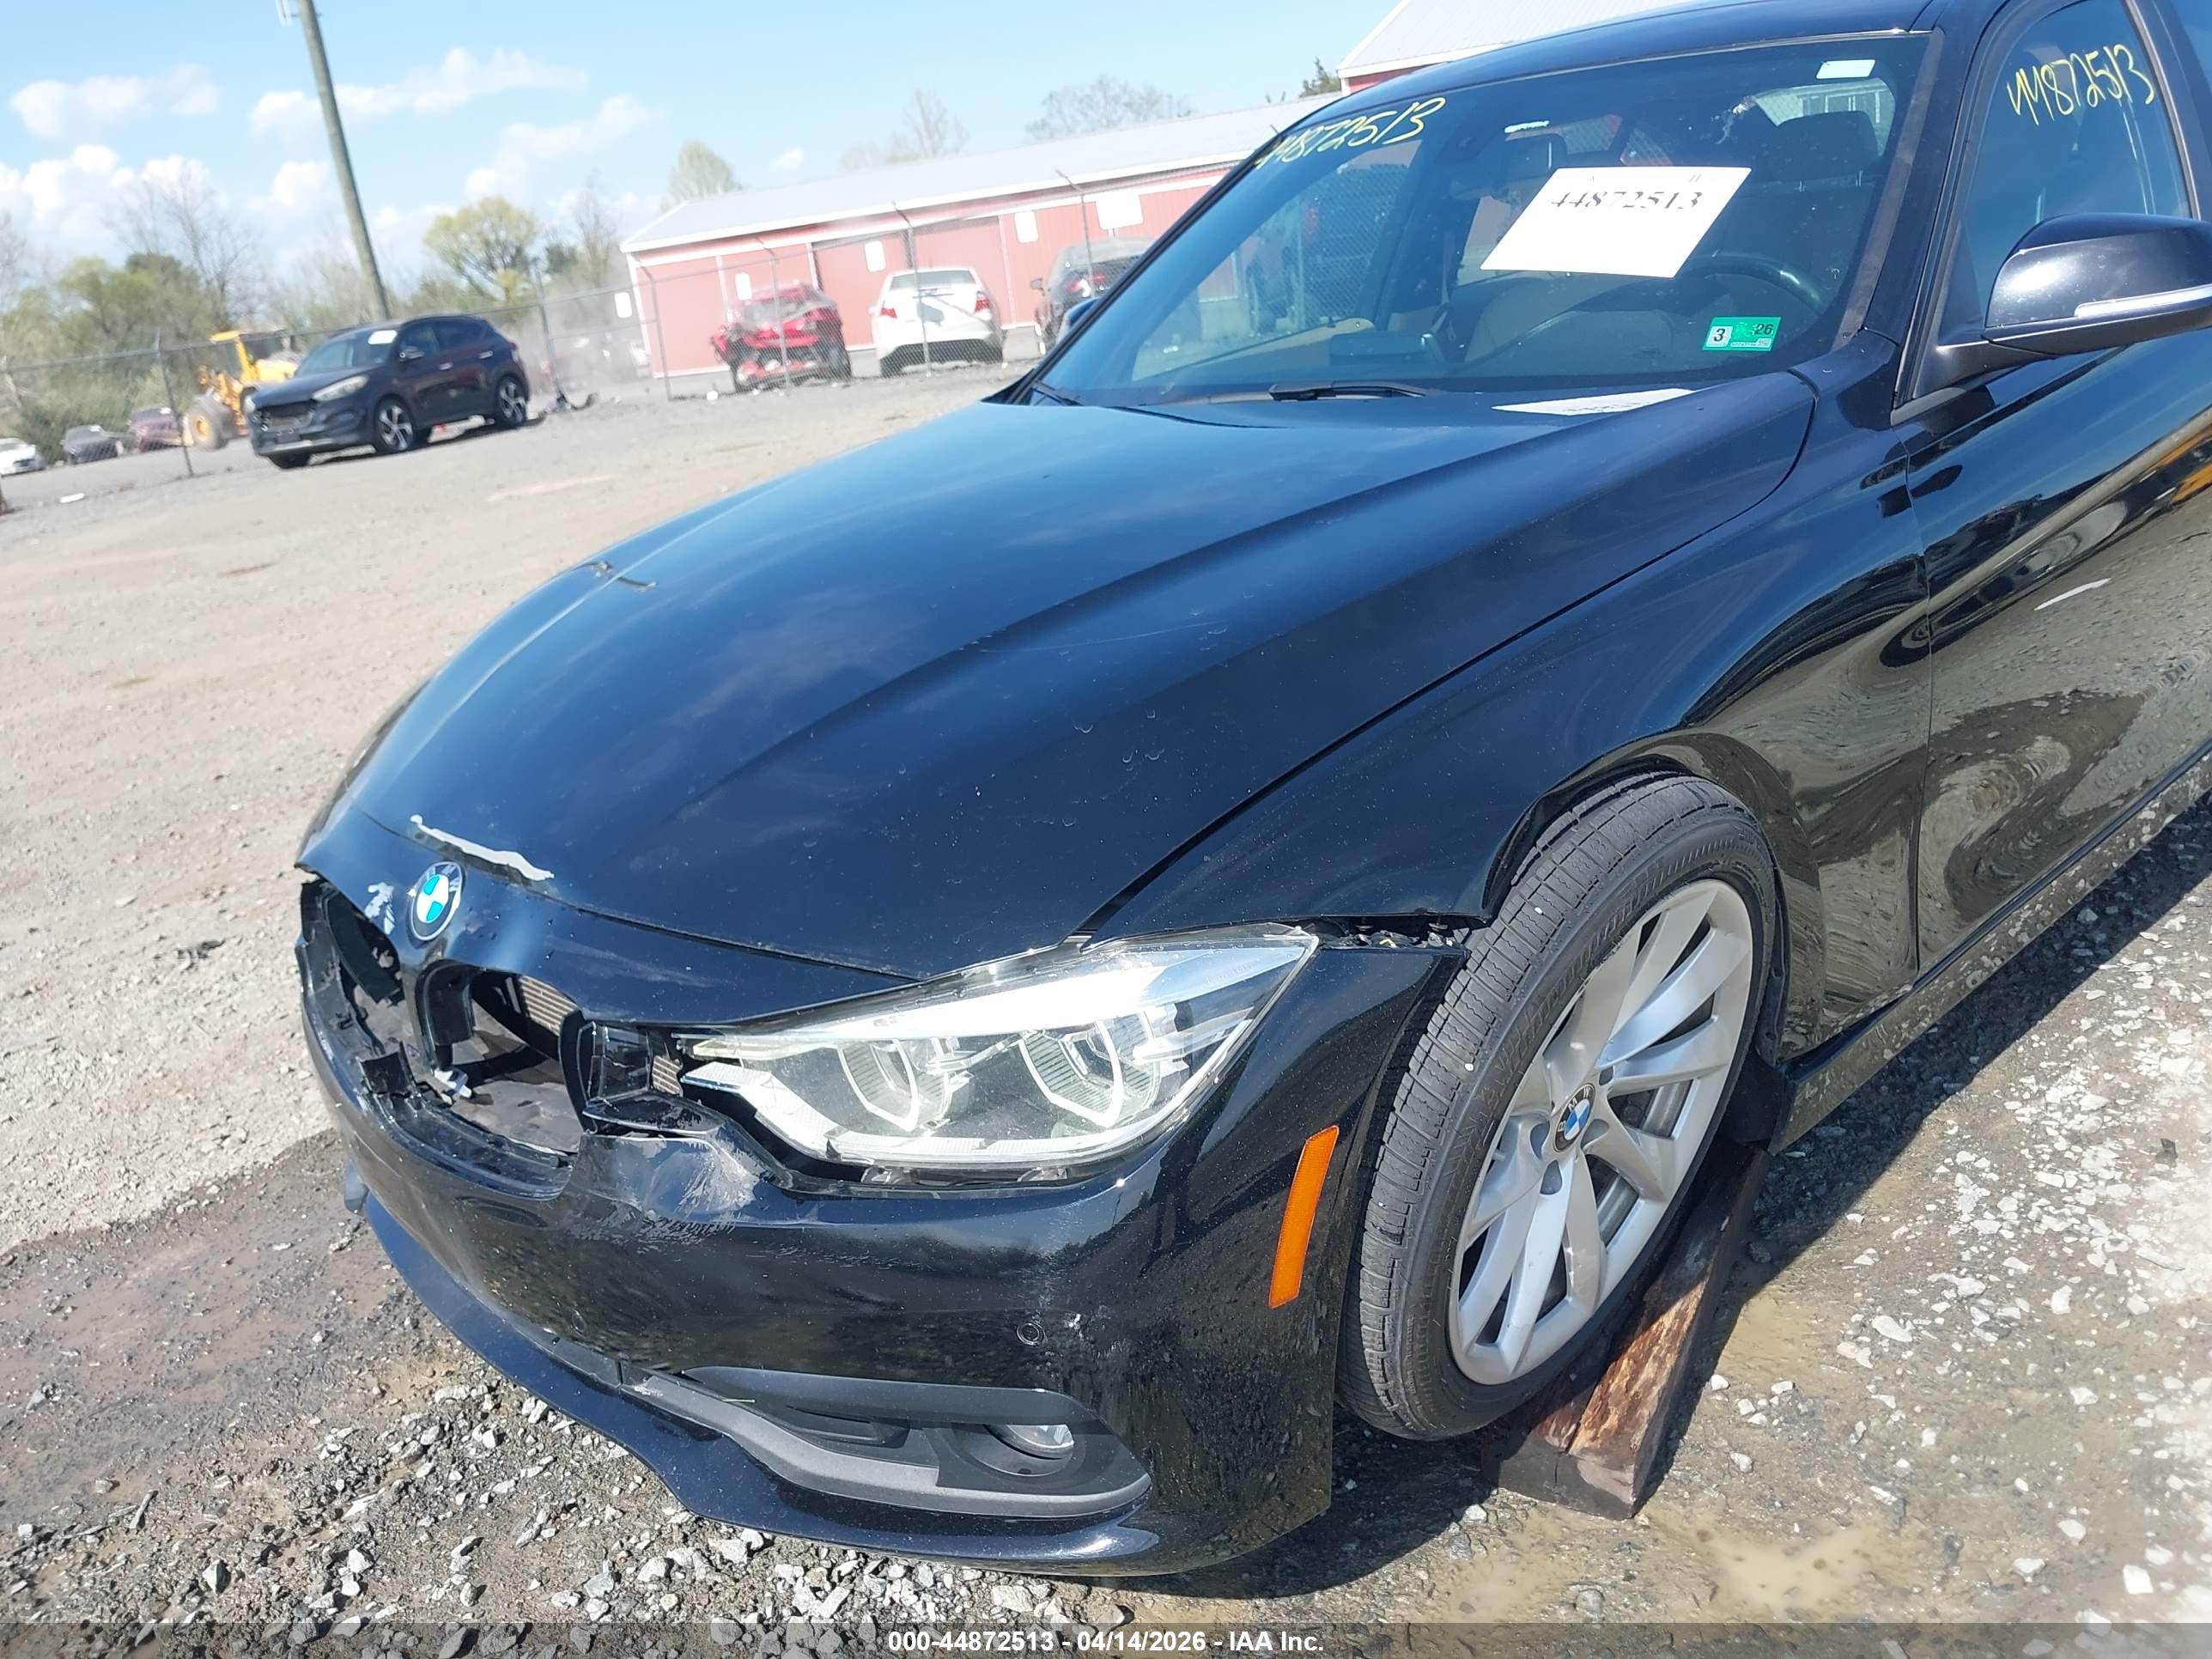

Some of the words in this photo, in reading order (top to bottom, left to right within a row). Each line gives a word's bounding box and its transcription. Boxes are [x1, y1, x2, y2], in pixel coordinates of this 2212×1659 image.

[2006, 44, 2155, 126] 44872513
[1551, 190, 1704, 210] 44872513
[1713, 328, 1726, 342] 3
[1754, 323, 1774, 336] 26
[1557, 1086, 1591, 1133] BMW
